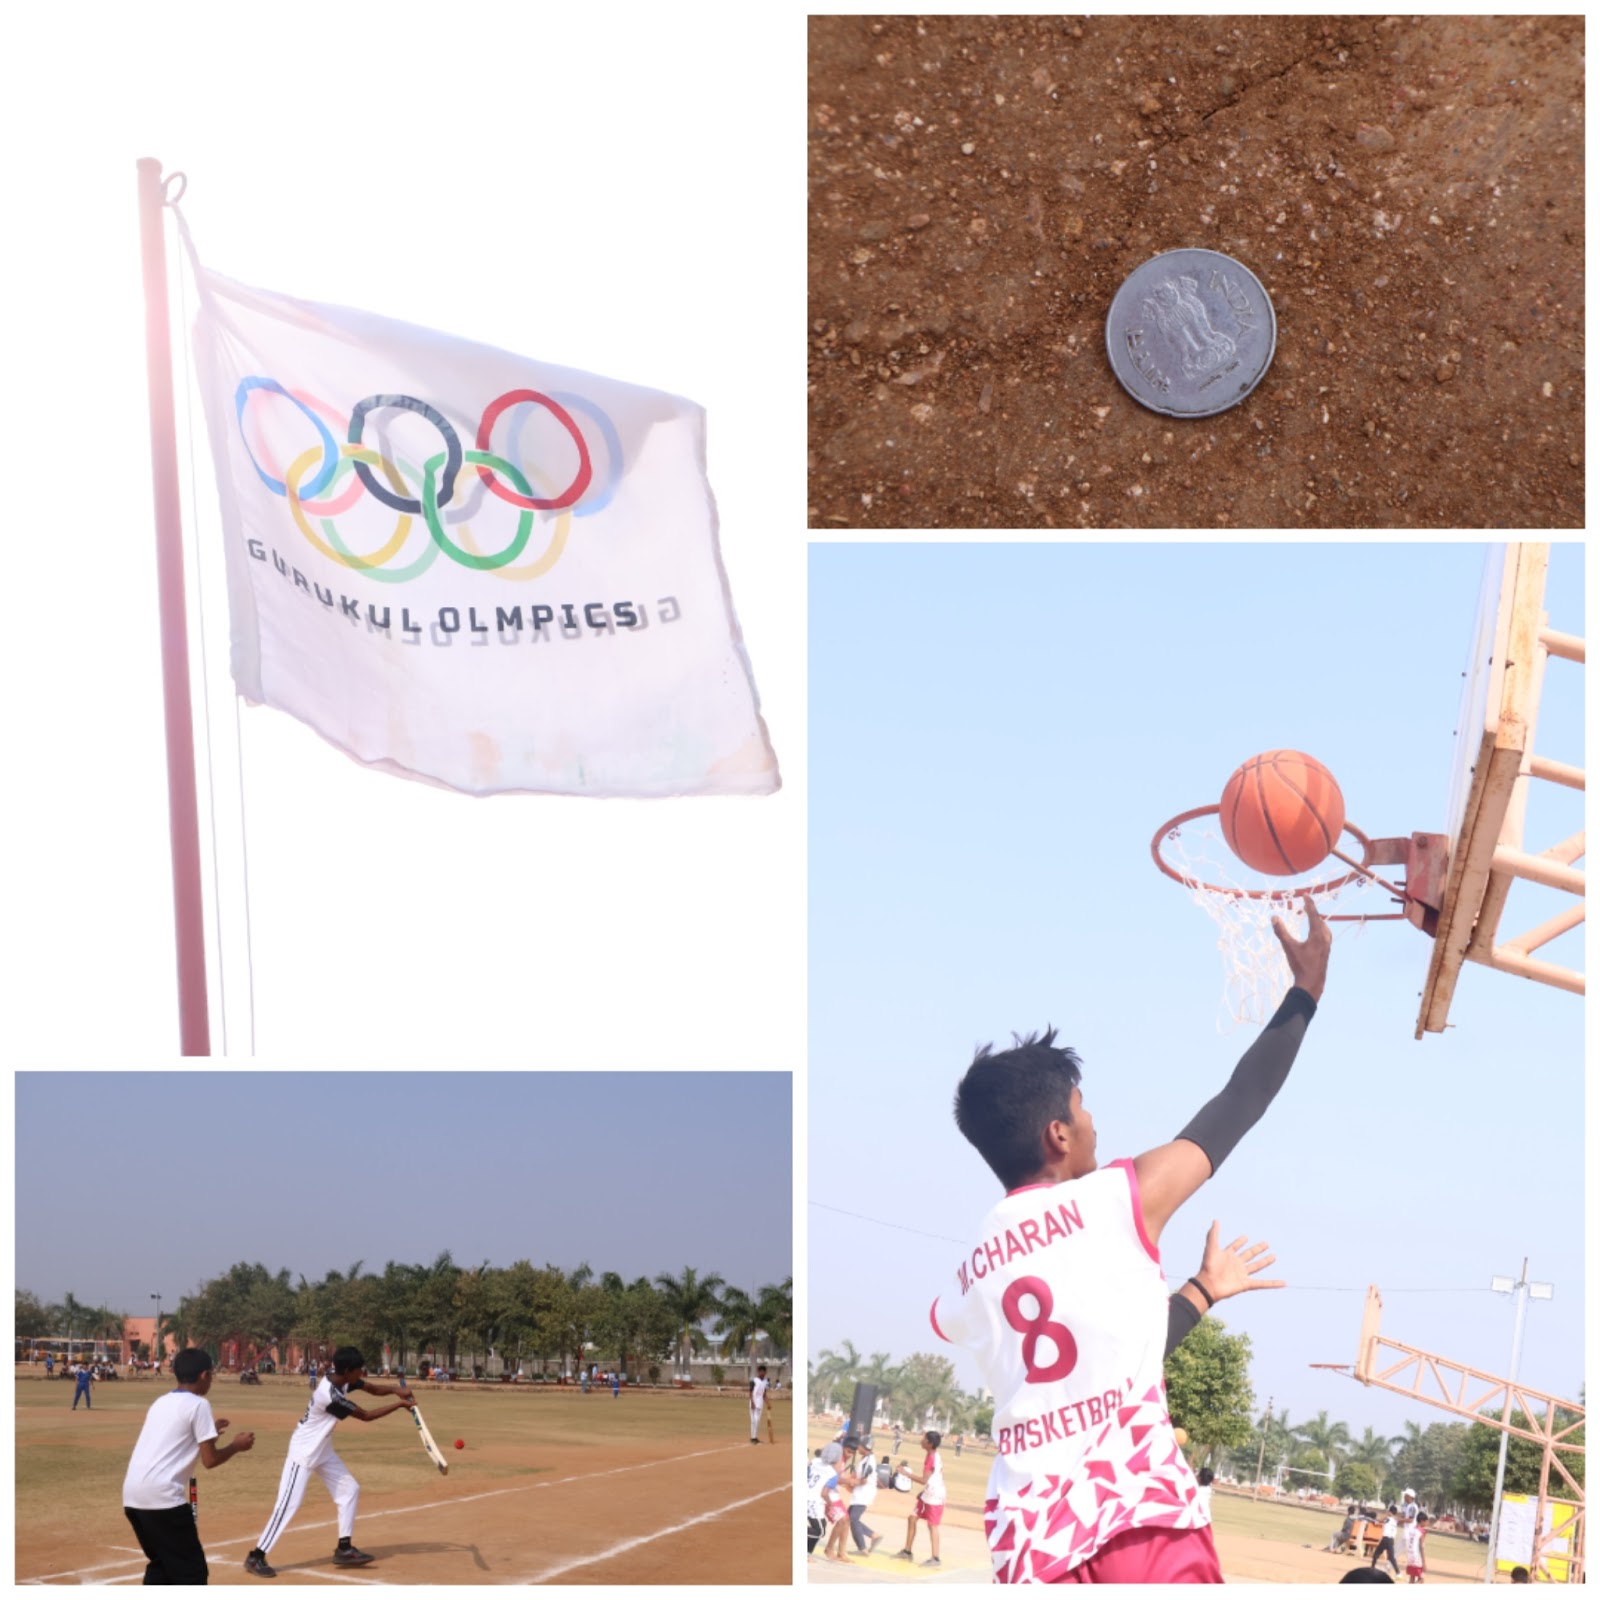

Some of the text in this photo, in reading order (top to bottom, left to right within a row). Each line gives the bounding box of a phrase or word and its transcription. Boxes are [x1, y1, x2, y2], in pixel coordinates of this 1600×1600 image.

[1209, 270, 1257, 338] INDIA
[248, 538, 422, 633] GURUKUL
[438, 601, 638, 633] OLMPICS
[1002, 1275, 1078, 1384] 8
[999, 1377, 1133, 1456] BASKETBA
